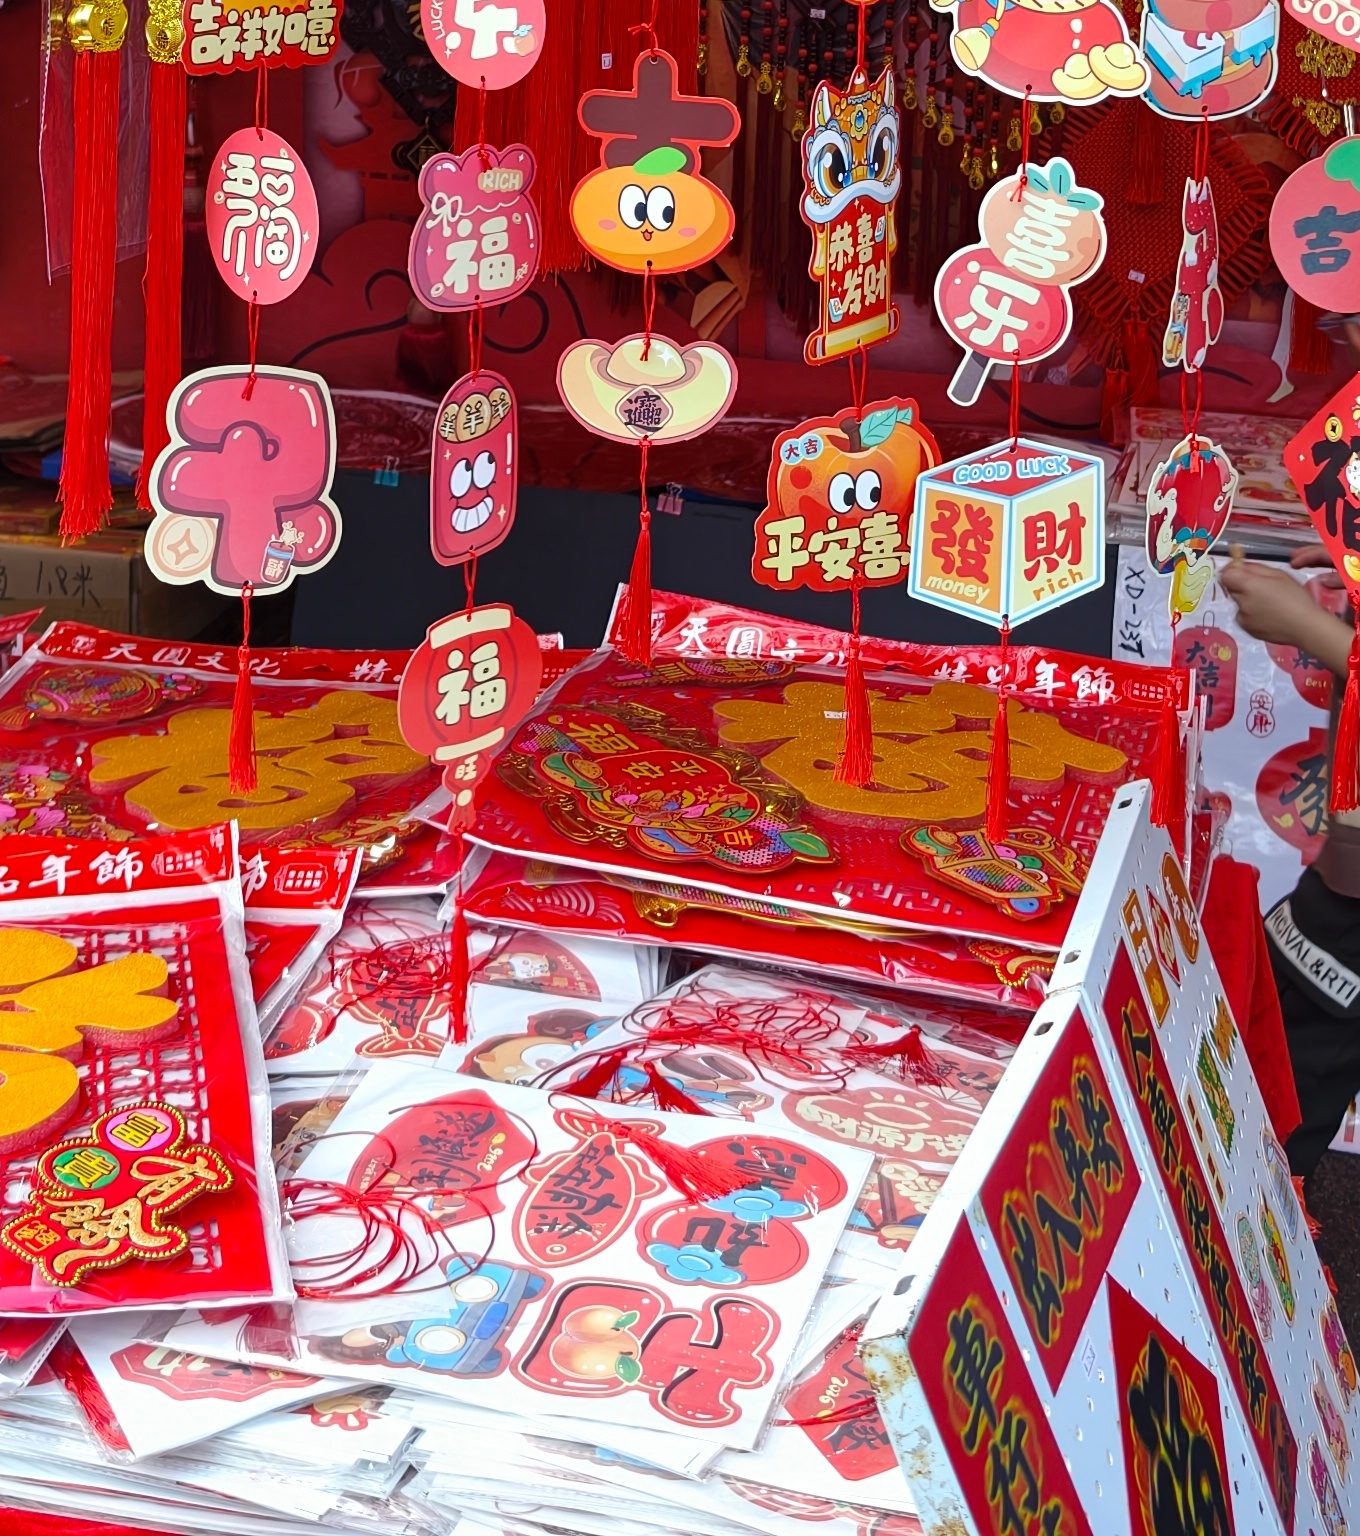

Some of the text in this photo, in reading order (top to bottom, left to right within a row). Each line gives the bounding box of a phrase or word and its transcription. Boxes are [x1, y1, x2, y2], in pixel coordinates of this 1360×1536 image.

[482, 170, 522, 190] RICH
[444, 216, 515, 293] 福
[829, 216, 874, 267] 恭喜
[842, 263, 886, 315] 发财
[954, 188, 1078, 354] 喜乐
[783, 437, 818, 460] 大吉
[954, 455, 1070, 484] GOOD LUCK
[932, 499, 996, 584] 發
[1024, 506, 1085, 581] 財
[926, 573, 990, 604] money
[1033, 566, 1083, 601] rich
[435, 644, 508, 725] 福
[455, 758, 478, 780] 旺
